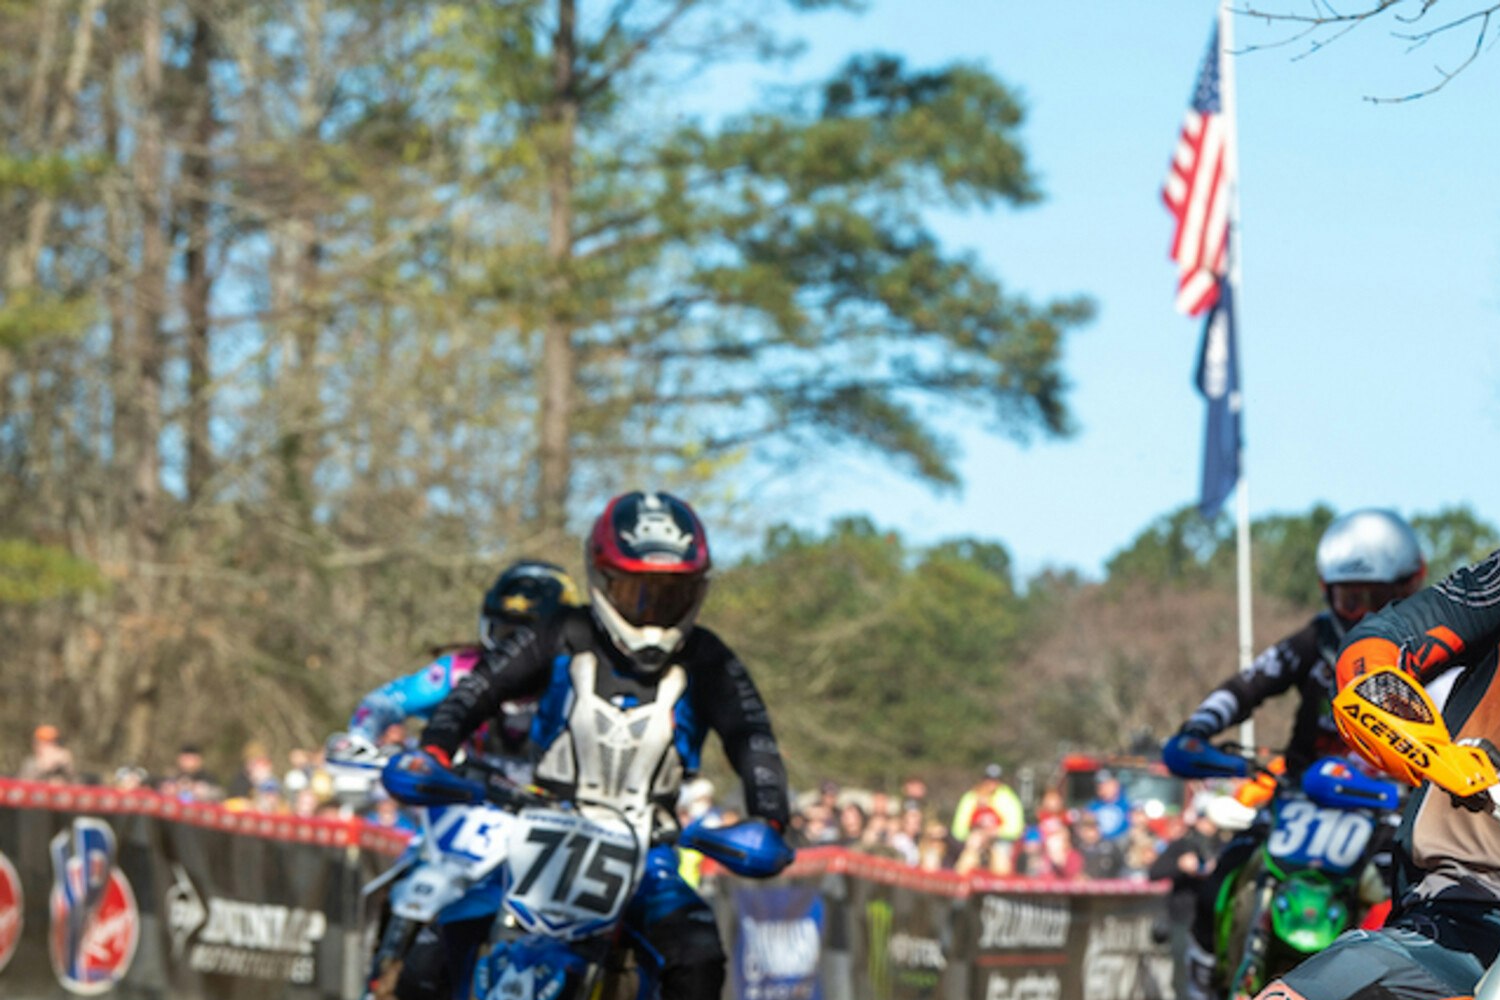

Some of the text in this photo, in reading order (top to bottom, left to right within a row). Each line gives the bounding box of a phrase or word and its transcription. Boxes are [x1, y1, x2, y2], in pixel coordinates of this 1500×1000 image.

[1342, 703, 1430, 768] ACERBIS
[1268, 801, 1374, 867] 310
[514, 827, 640, 916] 715
